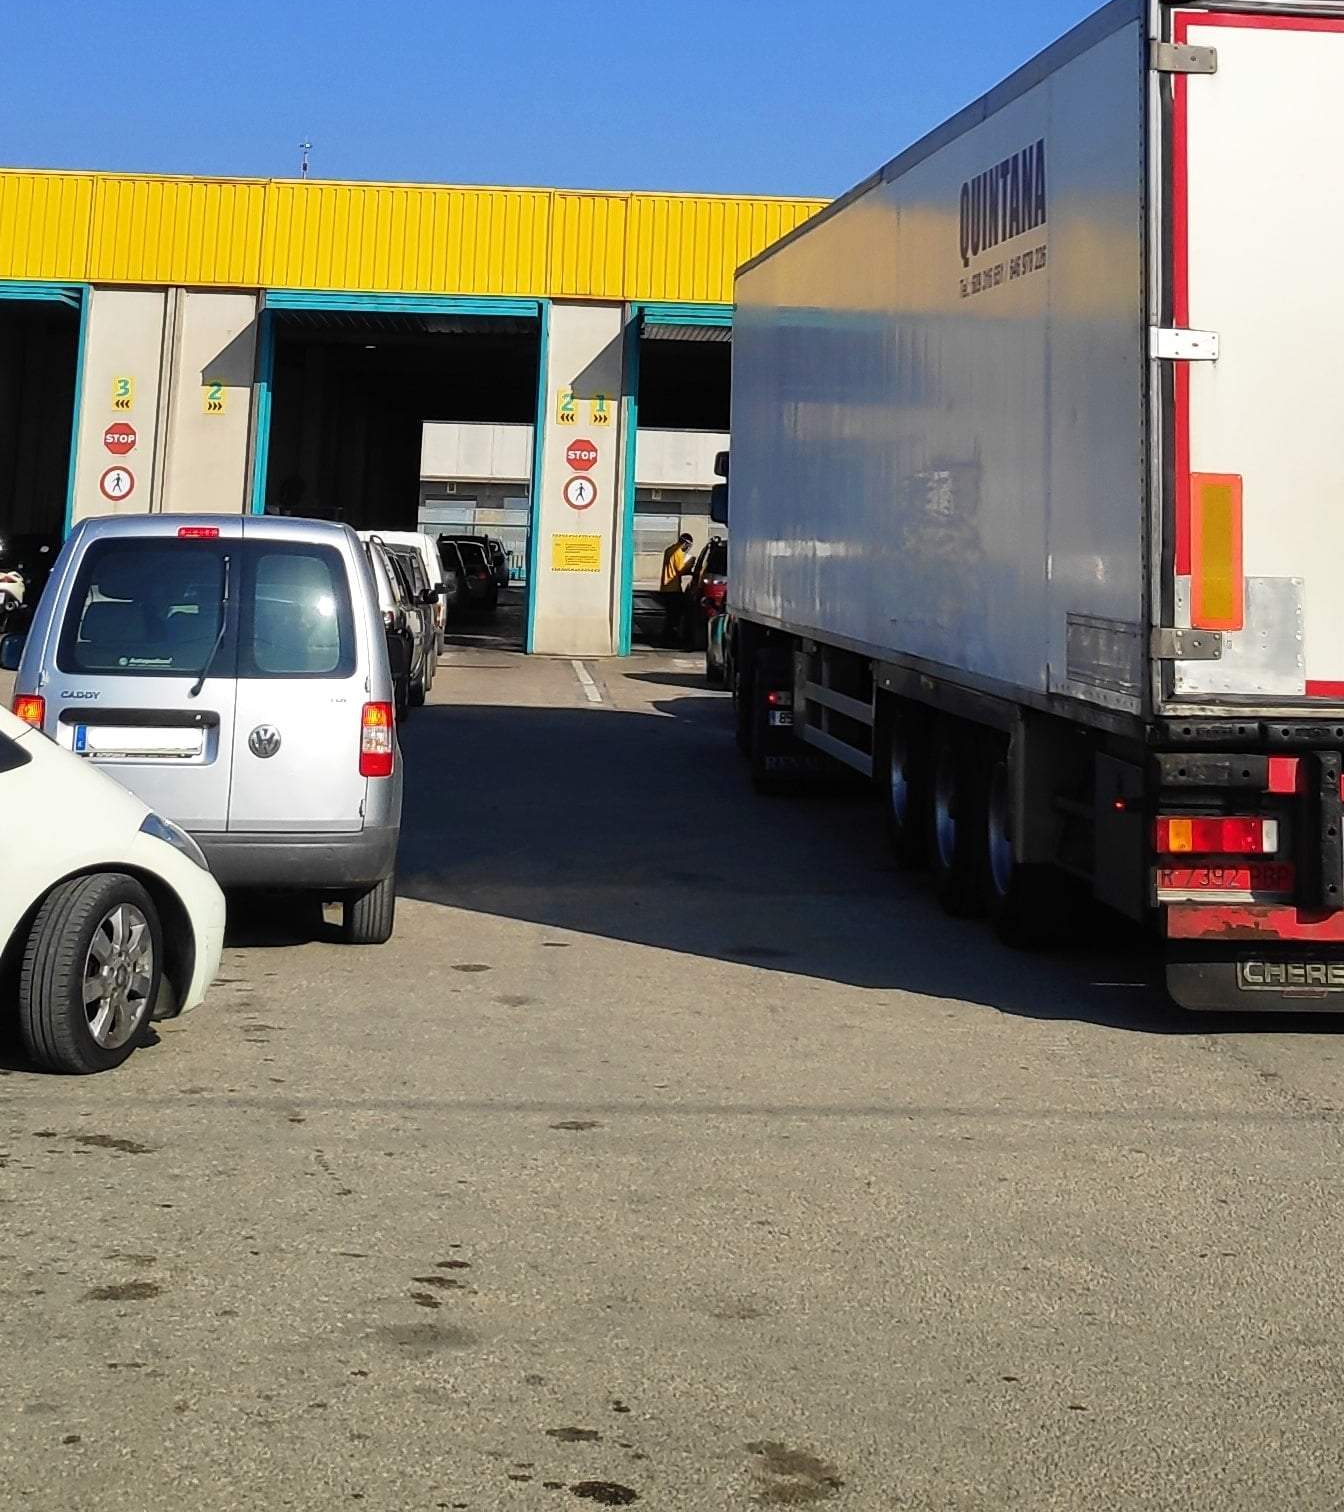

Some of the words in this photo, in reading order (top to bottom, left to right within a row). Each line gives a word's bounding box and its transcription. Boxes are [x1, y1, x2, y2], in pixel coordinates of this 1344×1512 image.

[960, 138, 1047, 268] QUINTANA
[116, 379, 130, 396] 3
[207, 382, 223, 400] 2
[560, 393, 574, 412] 2
[595, 393, 608, 413] 1
[105, 433, 136, 445] STOP
[567, 449, 598, 461] STOP
[60, 690, 101, 700] CADDY
